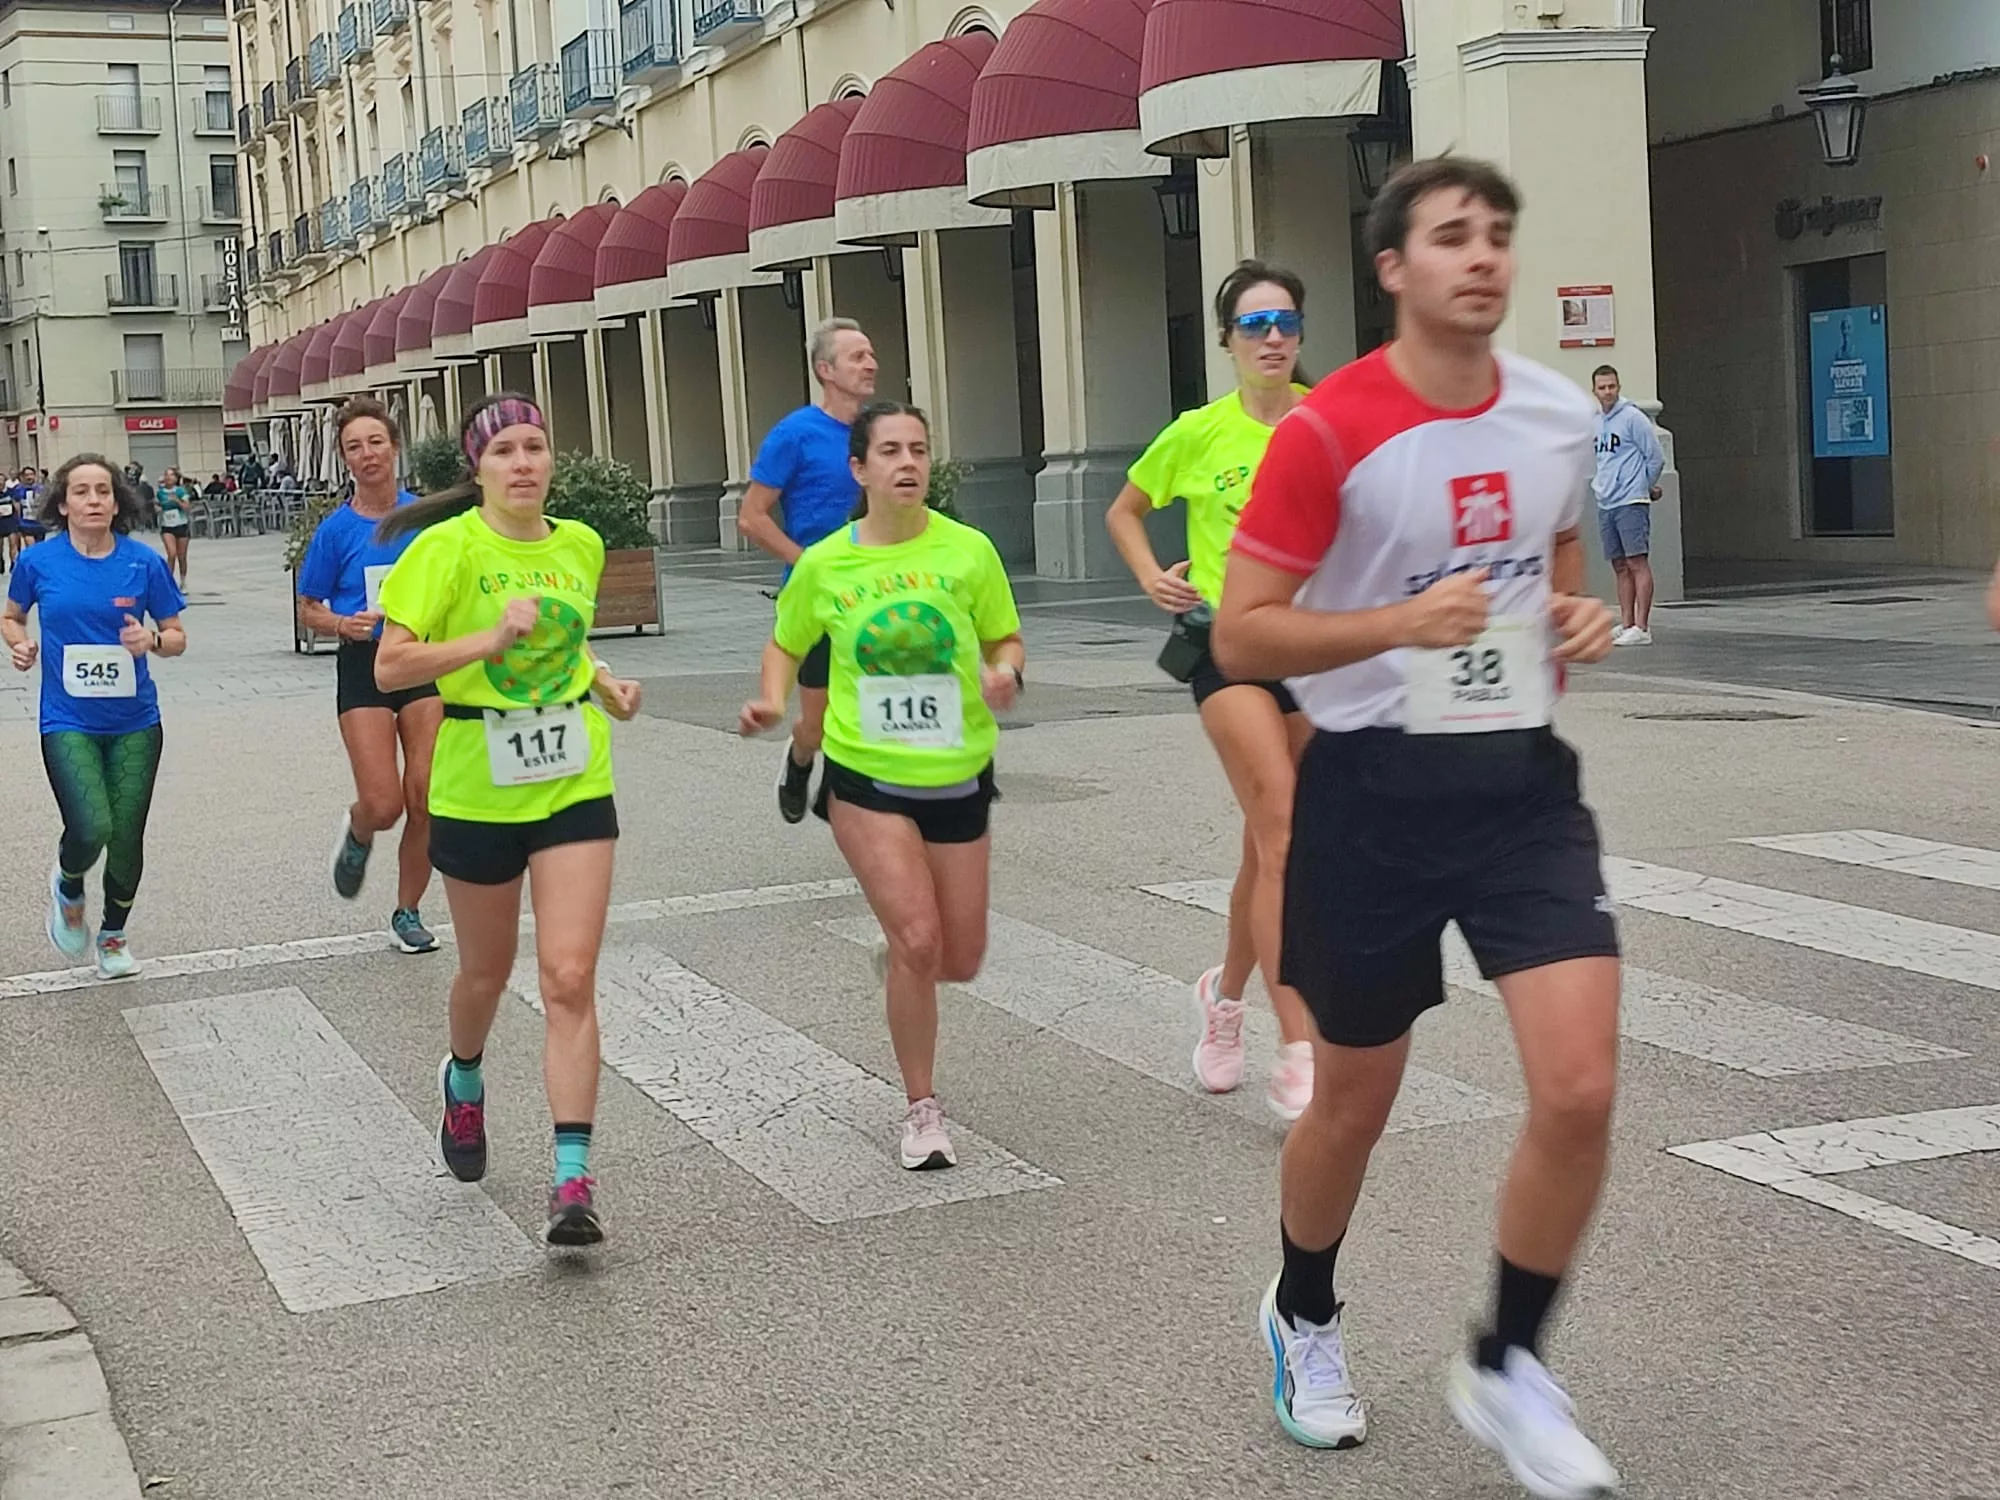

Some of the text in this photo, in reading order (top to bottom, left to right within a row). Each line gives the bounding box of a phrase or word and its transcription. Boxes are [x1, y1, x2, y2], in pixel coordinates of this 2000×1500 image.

[223, 237, 239, 324] HOSTAL
[139, 418, 165, 429] GAES
[75, 662, 119, 680] 545
[1449, 648, 1502, 686] 38
[878, 695, 938, 720] 116
[507, 724, 567, 757] 117
[523, 751, 567, 768] ESTER
